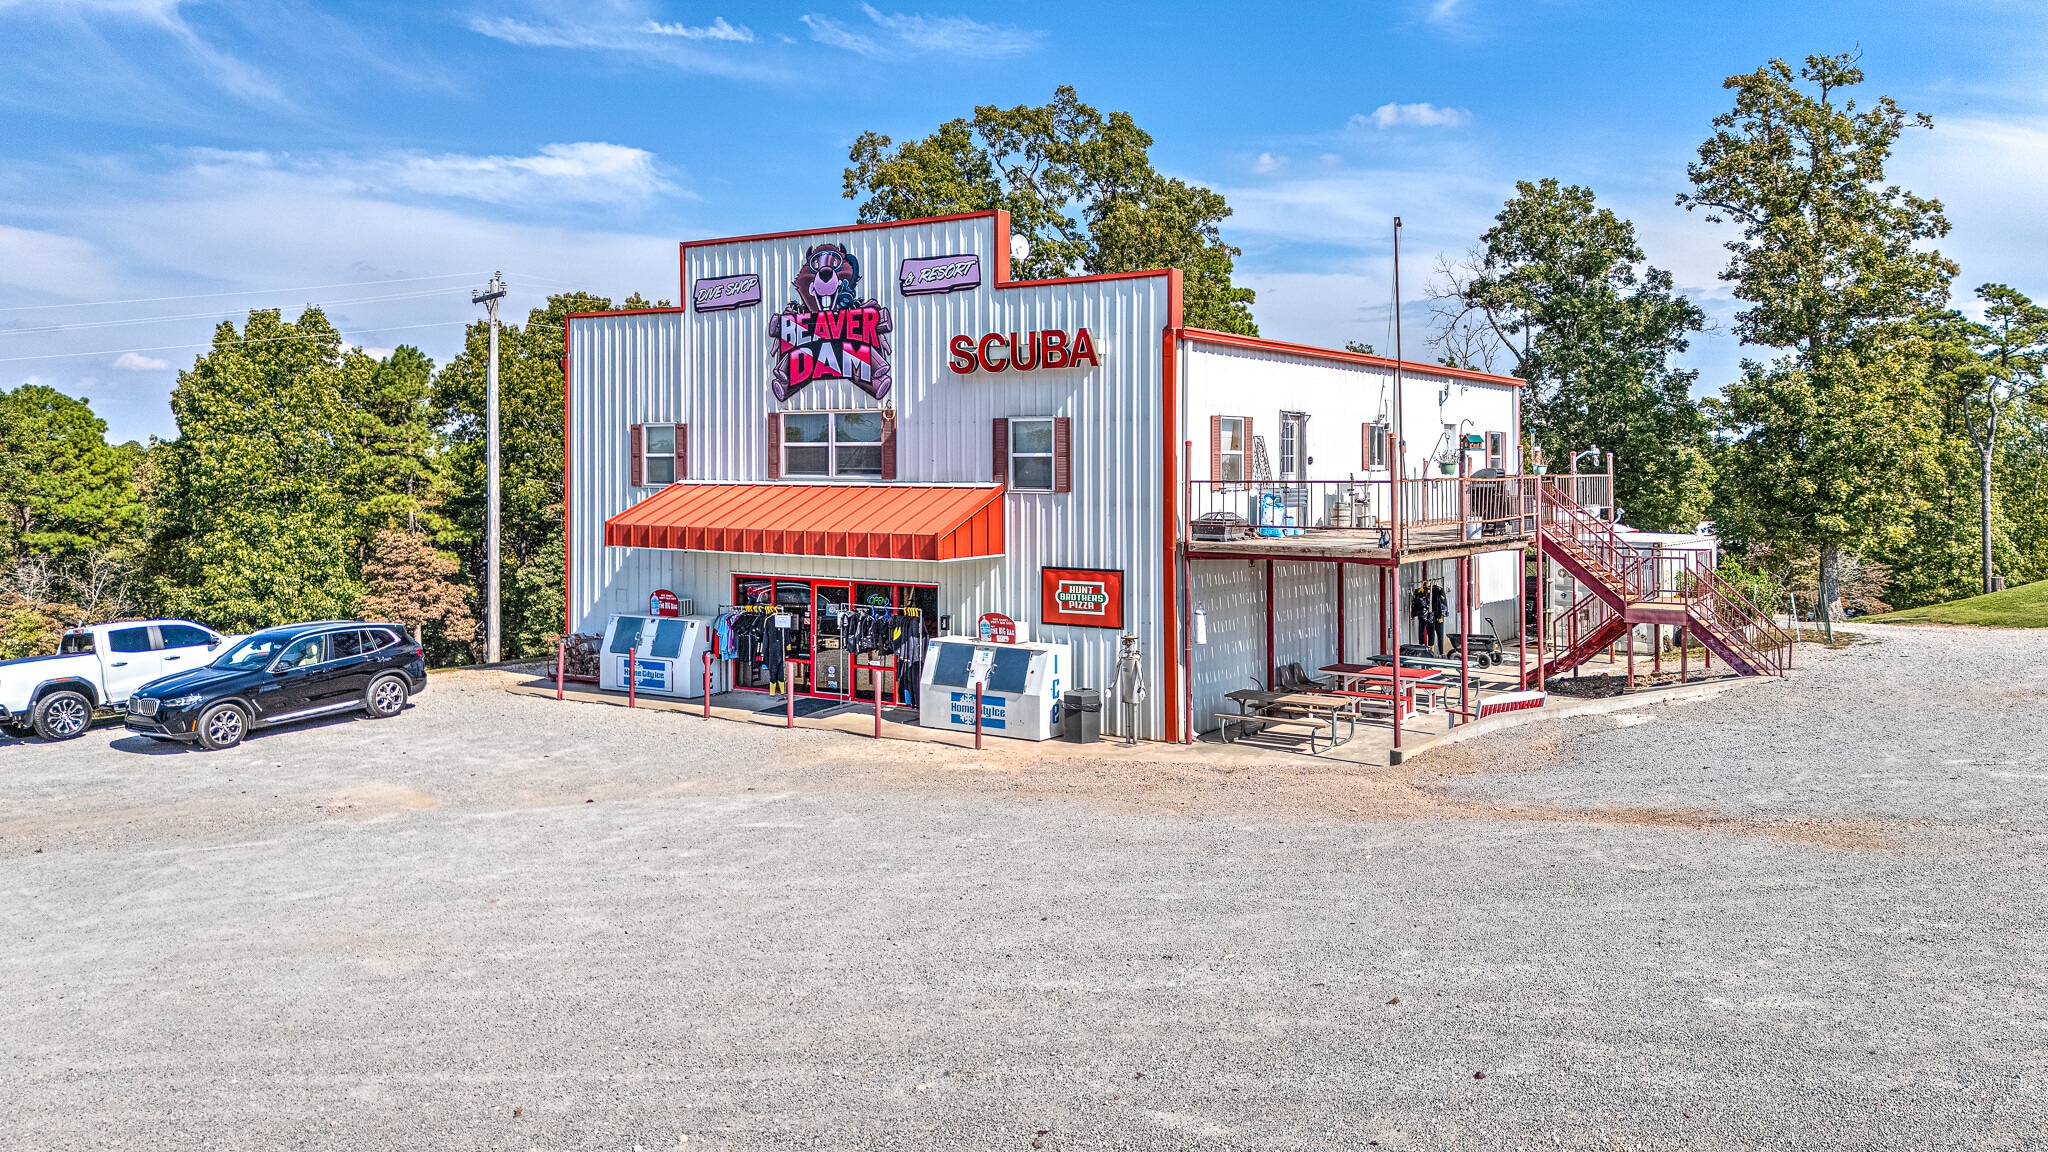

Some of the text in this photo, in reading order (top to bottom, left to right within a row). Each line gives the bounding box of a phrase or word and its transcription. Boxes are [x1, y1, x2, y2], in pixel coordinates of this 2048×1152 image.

[904, 260, 977, 286] & RESORT
[697, 278, 758, 302] DIVE SHOP
[781, 307, 880, 354] BEAVER
[949, 327, 1099, 375] SCUBA
[789, 341, 871, 387] DAM
[1060, 592, 1104, 602] BROTHERS
[1069, 585, 1094, 594] HUNT
[1068, 600, 1095, 610] PIZZA
[655, 671, 665, 679] Ice
[951, 702, 975, 714] Home
[992, 706, 1006, 718] Ice
